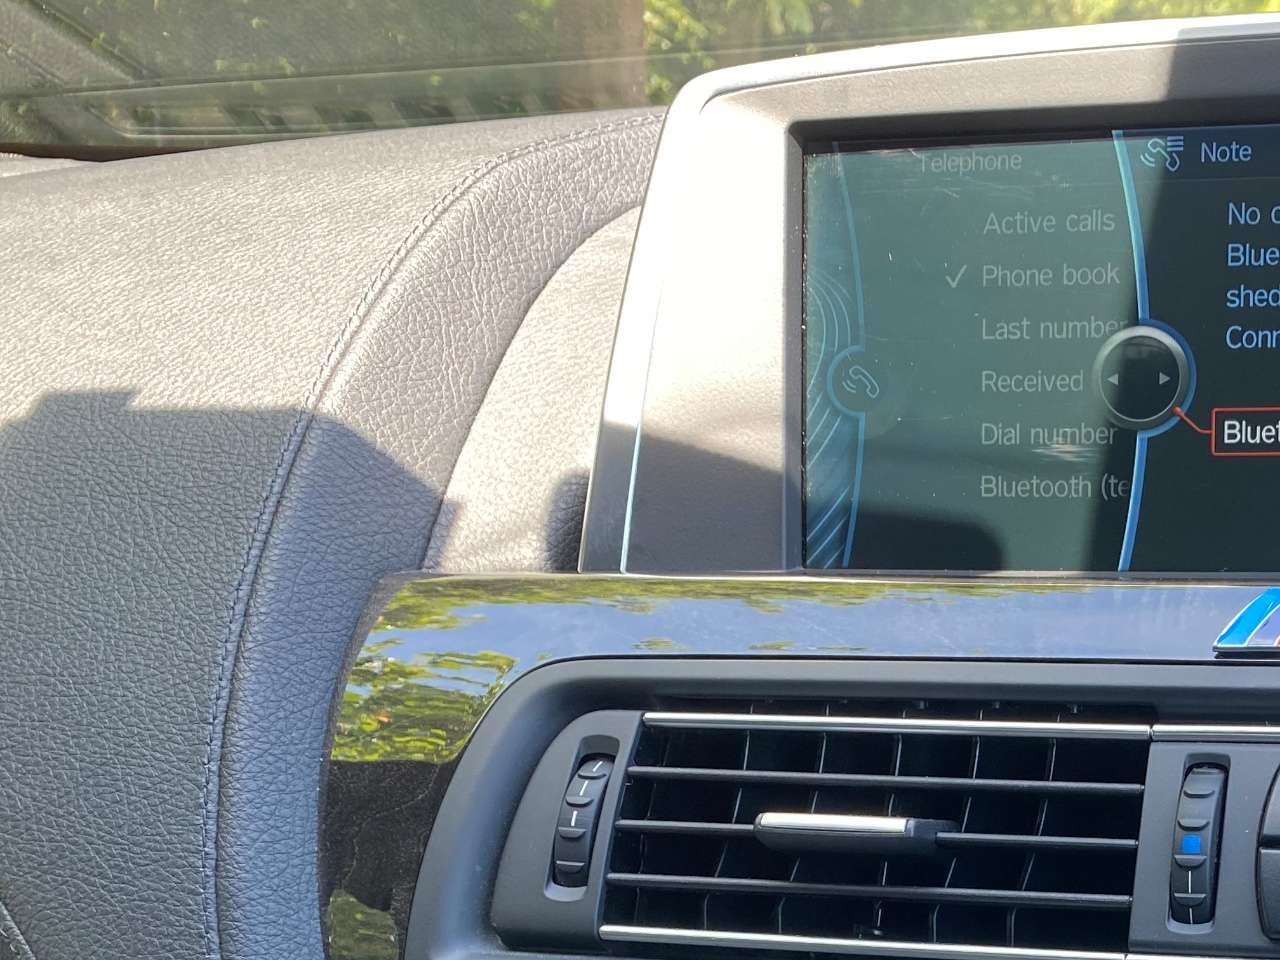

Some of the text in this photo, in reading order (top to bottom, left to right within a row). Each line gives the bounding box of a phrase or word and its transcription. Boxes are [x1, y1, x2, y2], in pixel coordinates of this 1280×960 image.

[918, 150, 1023, 177] Telephone
[1200, 142, 1252, 162] Note
[983, 209, 1116, 236] Active calls
[1227, 202, 1260, 225] No
[982, 262, 1121, 288] Phone book
[982, 318, 1030, 340] Last
[981, 369, 1084, 392] Received
[981, 422, 1116, 446] Dial number
[980, 475, 1092, 498] Bluetooth
